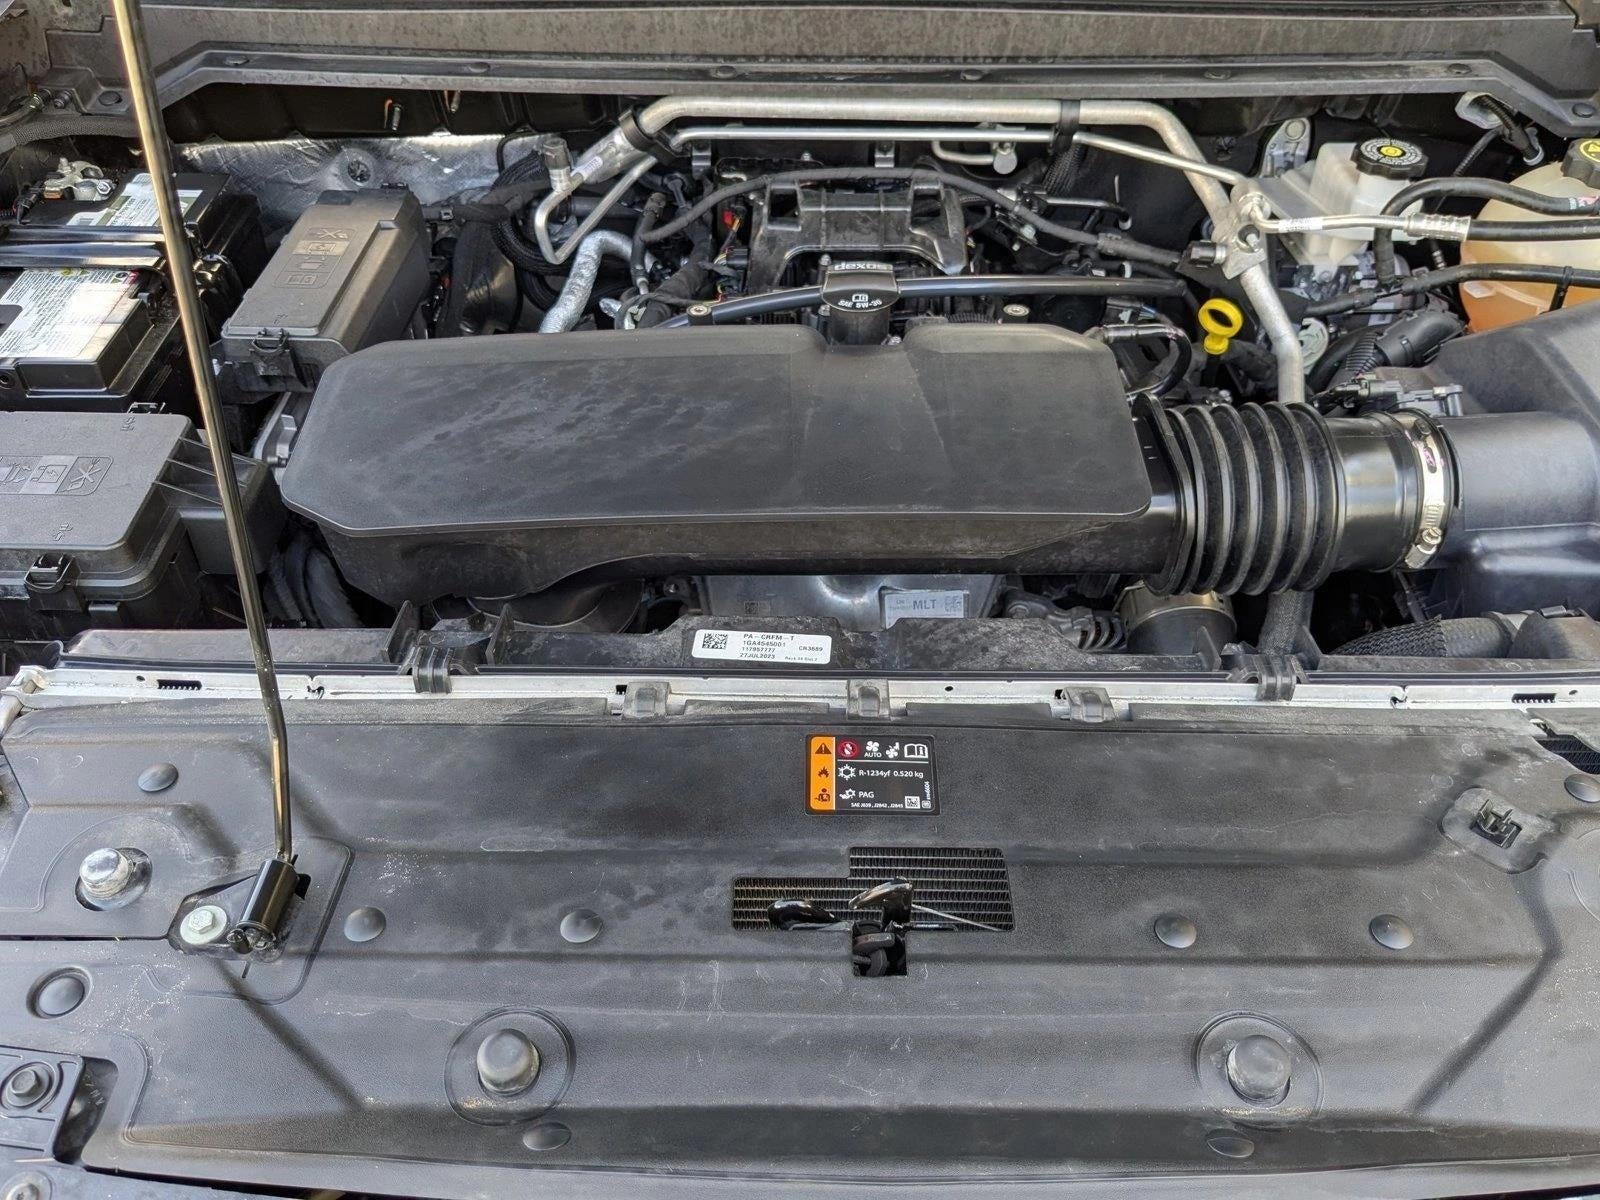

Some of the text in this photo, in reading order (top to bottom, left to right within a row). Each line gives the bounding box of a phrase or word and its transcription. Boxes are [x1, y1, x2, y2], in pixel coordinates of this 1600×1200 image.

[838, 300, 853, 308] SAE
[912, 600, 936, 610] MLT
[859, 769, 891, 778] R-1234yf
[914, 770, 924, 779] kg
